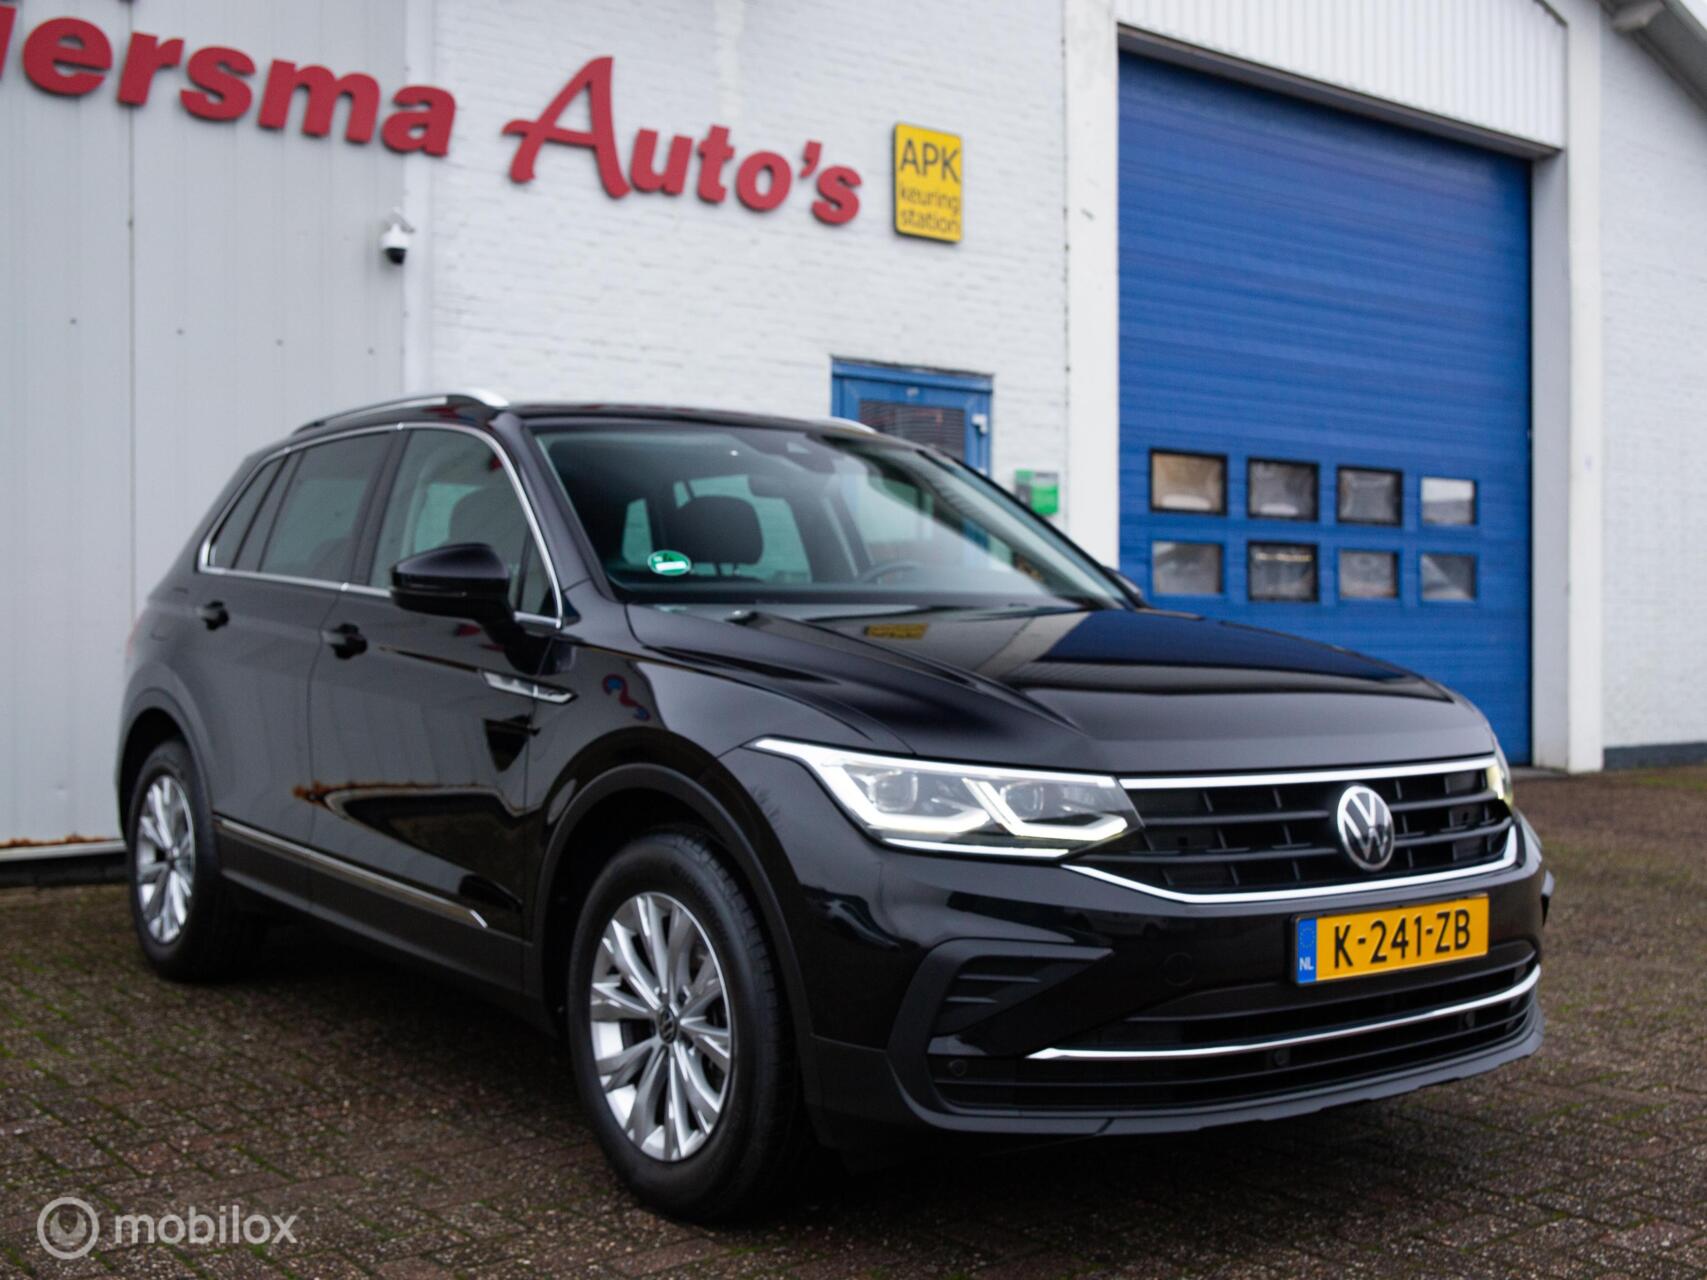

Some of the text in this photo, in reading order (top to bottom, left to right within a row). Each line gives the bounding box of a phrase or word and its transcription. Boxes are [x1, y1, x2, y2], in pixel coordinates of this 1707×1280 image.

[502, 56, 863, 225] Auto's
[899, 138, 960, 183] APK
[901, 209, 960, 233] station
[1334, 909, 1470, 969] K-241-ZB
[1299, 957, 1314, 970] NL
